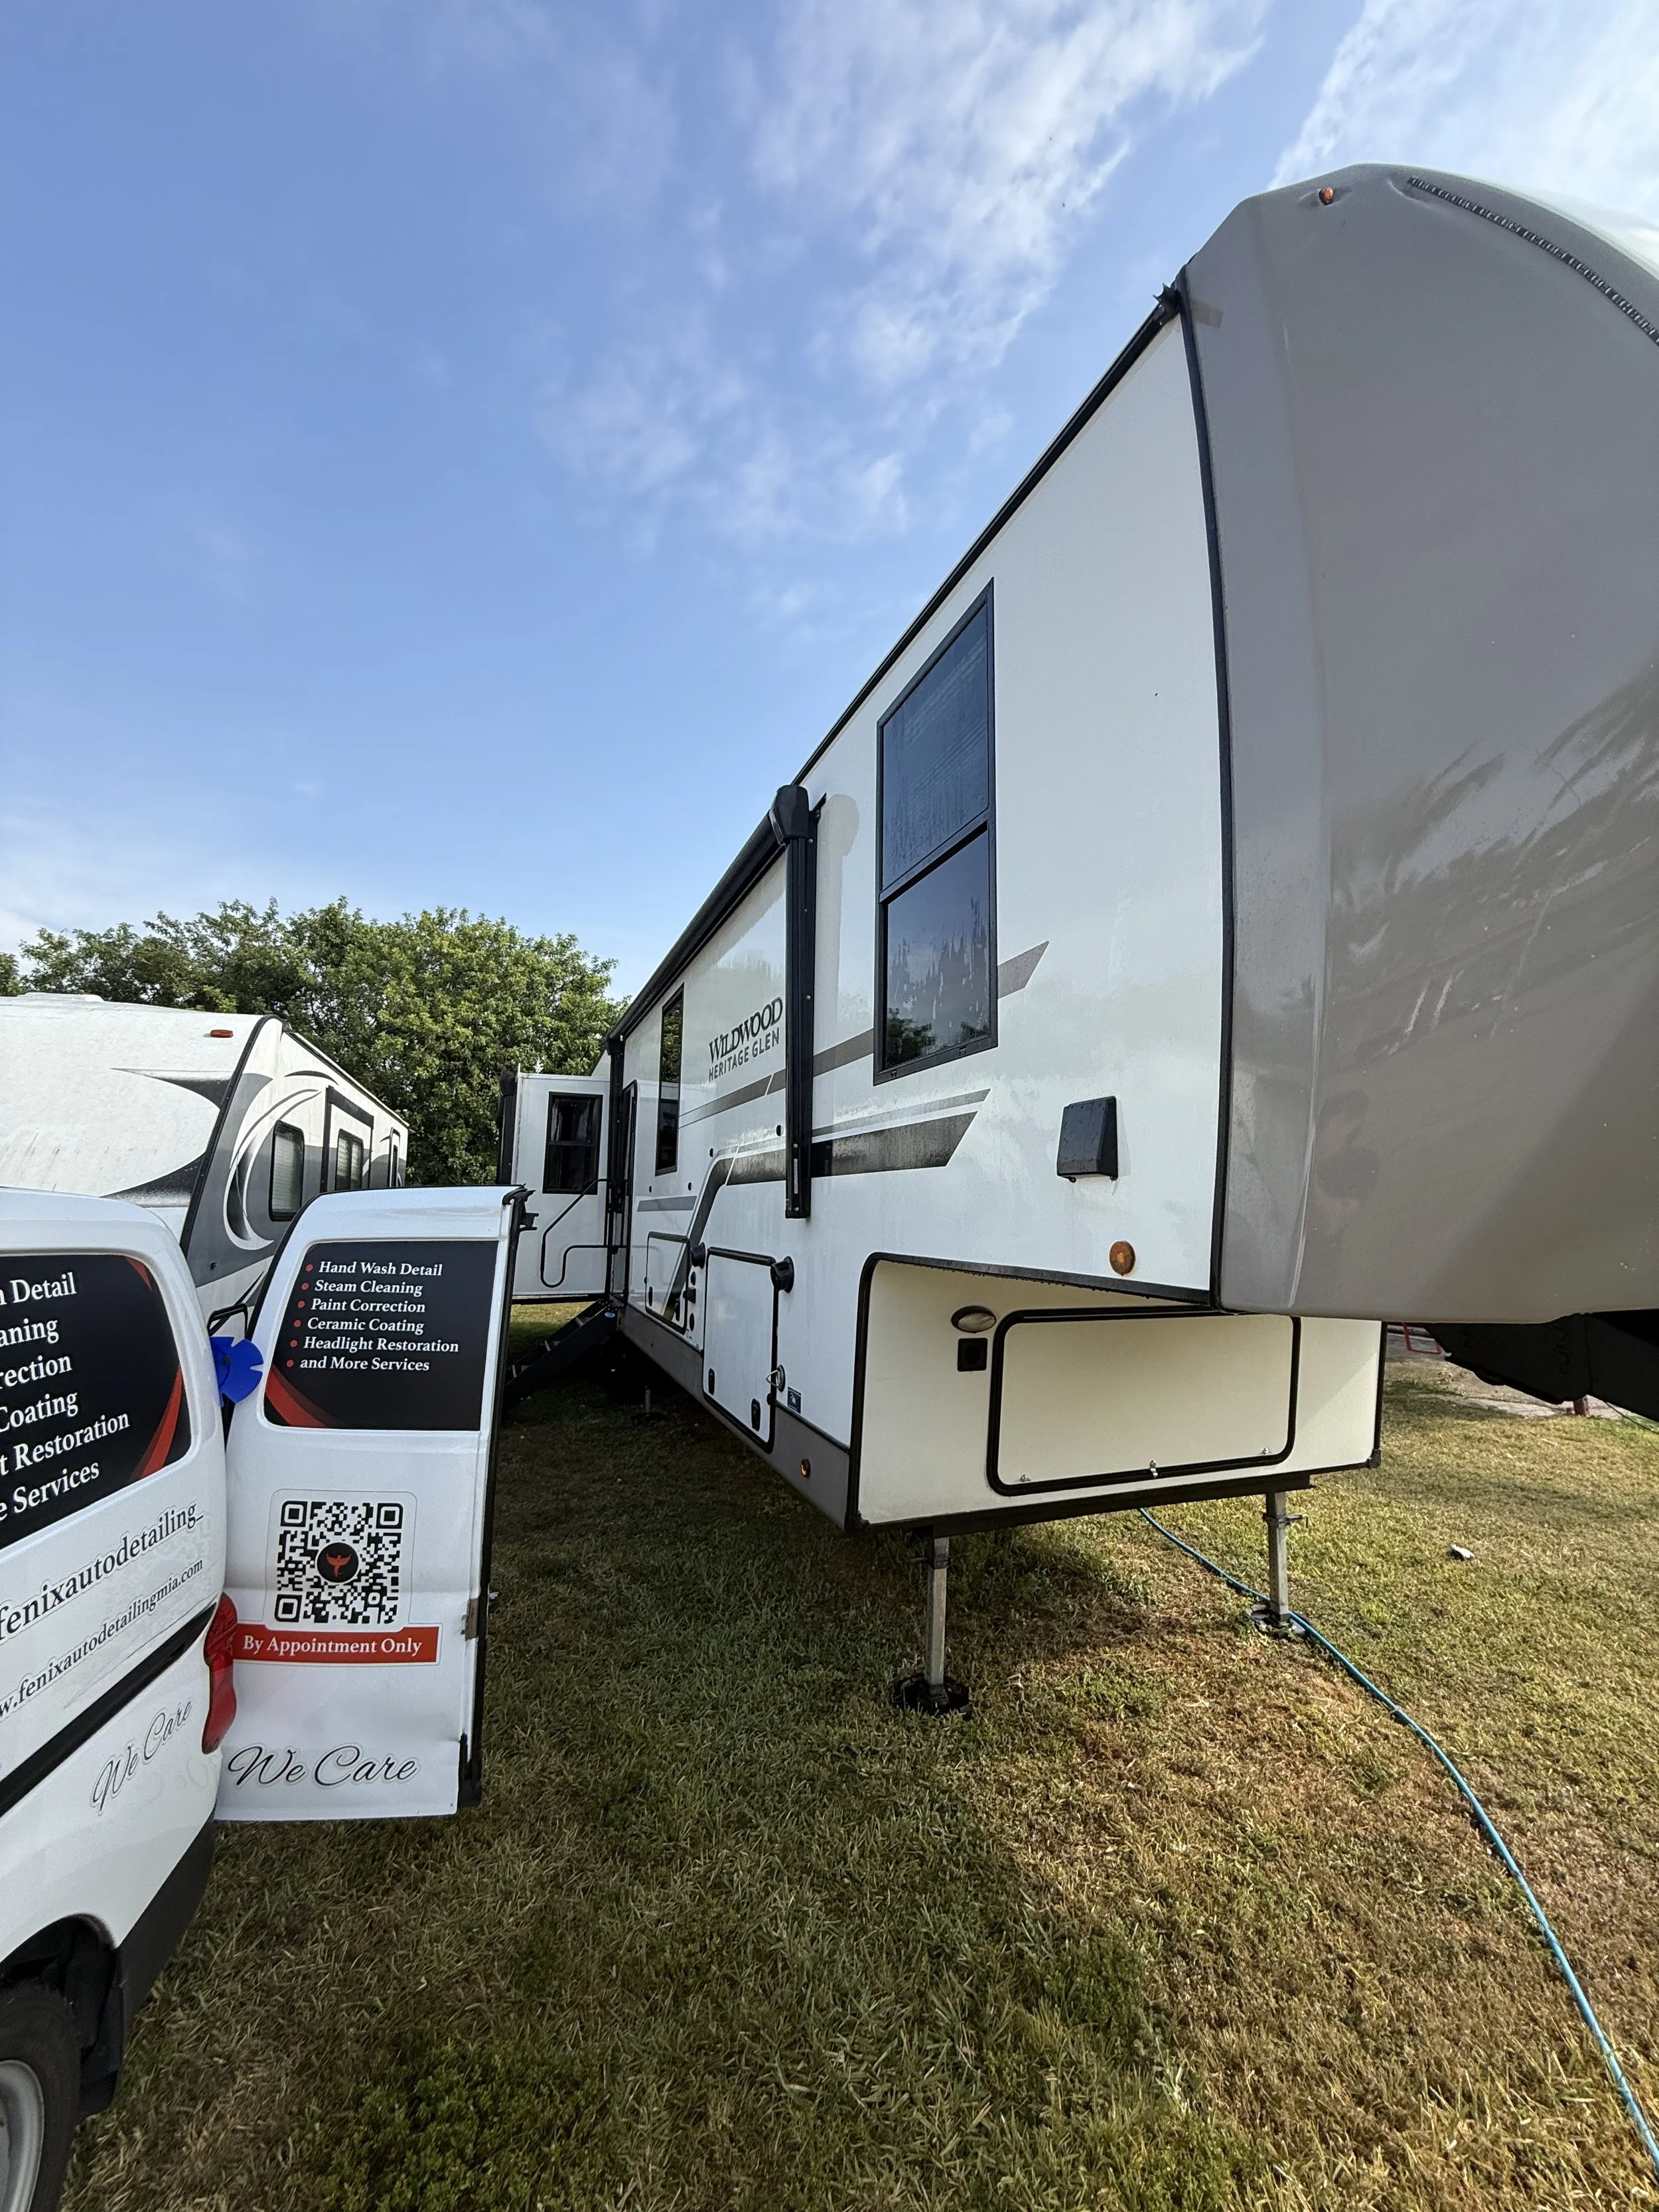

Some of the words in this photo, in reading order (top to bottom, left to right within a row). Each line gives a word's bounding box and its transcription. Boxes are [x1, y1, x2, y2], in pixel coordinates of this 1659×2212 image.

[709, 997, 783, 1063] WILDWOOD
[709, 1046, 749, 1082] HERITAGE
[752, 1027, 780, 1058] GLEN
[319, 1261, 357, 1274] Hand
[360, 1262, 397, 1275] Wash
[399, 1263, 443, 1276] Detail
[10, 1272, 77, 1303] Detail
[315, 1280, 357, 1292] Steam
[360, 1280, 423, 1297] Cleaning
[311, 1298, 347, 1311] Paint
[350, 1299, 425, 1313] Correction
[307, 1317, 366, 1331] Ceramic
[369, 1319, 425, 1335] Coating
[303, 1336, 374, 1353] Headlight
[376, 1337, 459, 1352] Restoration
[300, 1356, 327, 1368] and
[329, 1357, 368, 1370] More
[371, 1358, 430, 1370] Services
[13, 1413, 130, 1471] Restoration
[13, 1462, 100, 1513] Services
[243, 1635, 263, 1655] By
[266, 1636, 378, 1656] Appointment
[381, 1637, 423, 1656] Only
[92, 1745, 137, 1811] We
[144, 1701, 191, 1760] Care
[228, 1745, 306, 1785] We
[315, 1745, 417, 1786] Care
